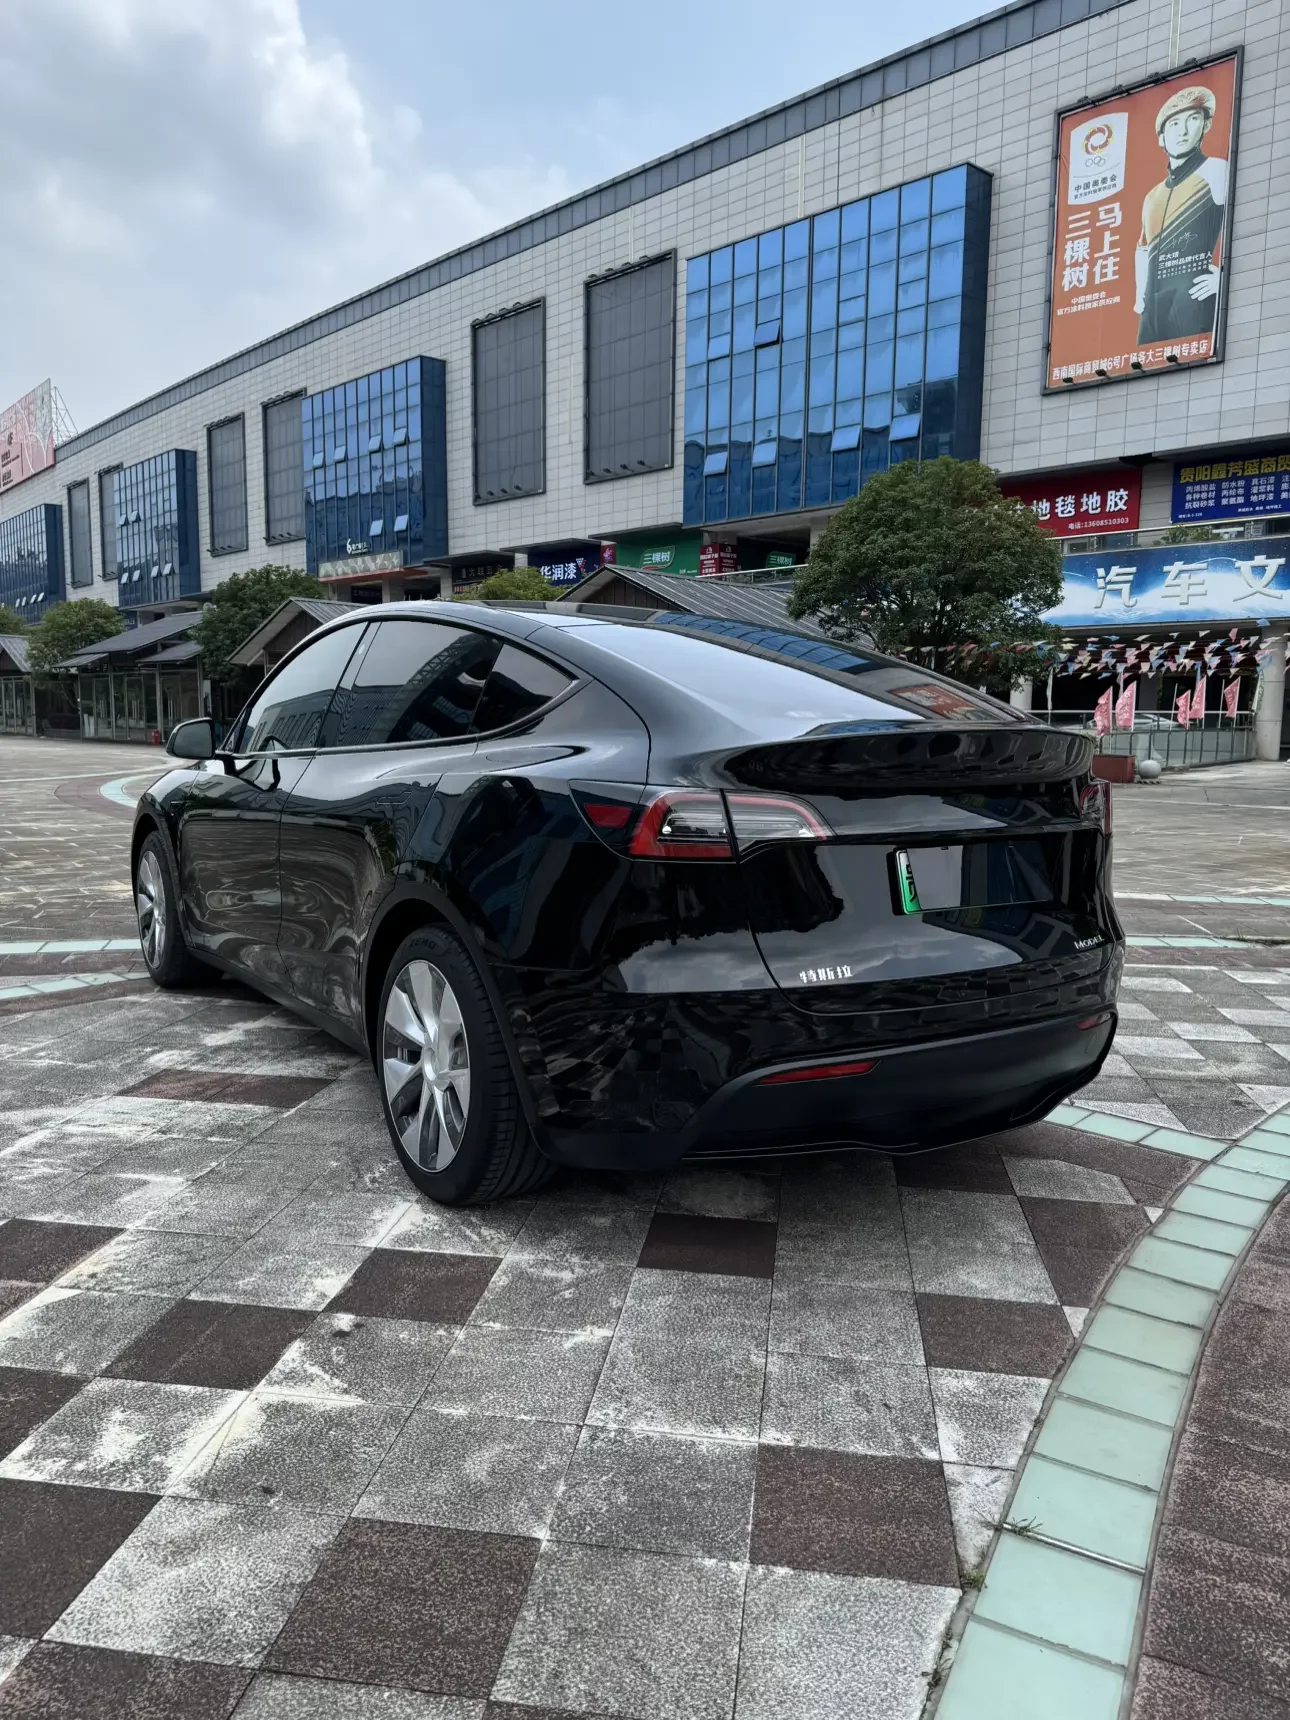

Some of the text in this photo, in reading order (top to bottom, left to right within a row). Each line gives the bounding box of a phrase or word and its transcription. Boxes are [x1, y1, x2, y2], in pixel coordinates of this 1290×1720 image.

[1074, 173, 1117, 193] 中国奥委会
[1062, 211, 1091, 292] 三棵树
[1093, 202, 1122, 285] 马上住
[1071, 291, 1107, 304] 中国奥委会
[1068, 517, 1129, 530] 电话:13608510303
[643, 551, 670, 565] 三棵树
[769, 555, 793, 566] 三棵树
[541, 562, 577, 581] 华润漆
[1073, 934, 1105, 949] MODEL
[799, 964, 853, 984] 特斯拉
